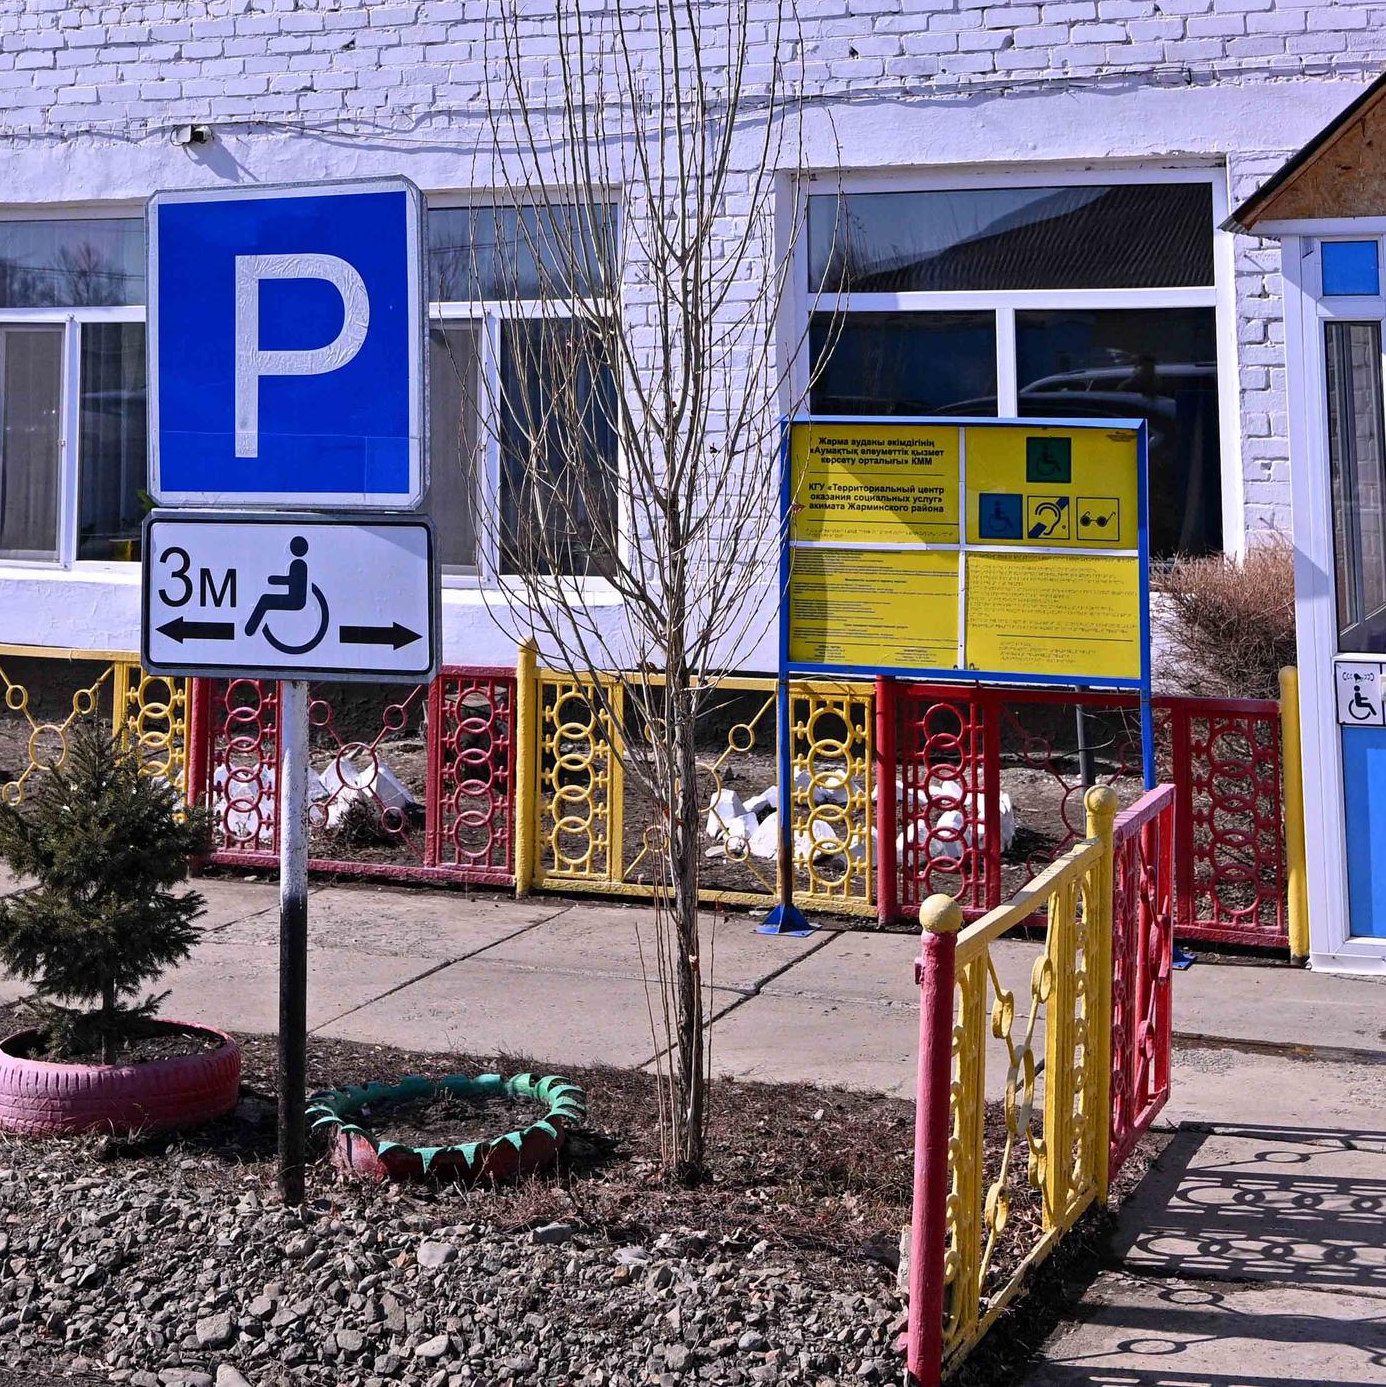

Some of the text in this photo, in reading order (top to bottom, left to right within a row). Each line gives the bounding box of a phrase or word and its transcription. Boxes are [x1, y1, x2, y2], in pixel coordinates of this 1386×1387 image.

[235, 253, 371, 458] P
[818, 437, 935, 448] Жарма ауданы әкімдігінің
[861, 448, 909, 457] әлеуметтік
[911, 449, 944, 457] қызмет
[821, 457, 856, 465] көрсету
[858, 458, 909, 466] орталығы»
[809, 483, 944, 495] КГУ «Территориальный центр
[810, 493, 851, 501] оказания
[913, 496, 943, 504] услуг»
[848, 504, 909, 512] Жарминского
[911, 505, 944, 513] района
